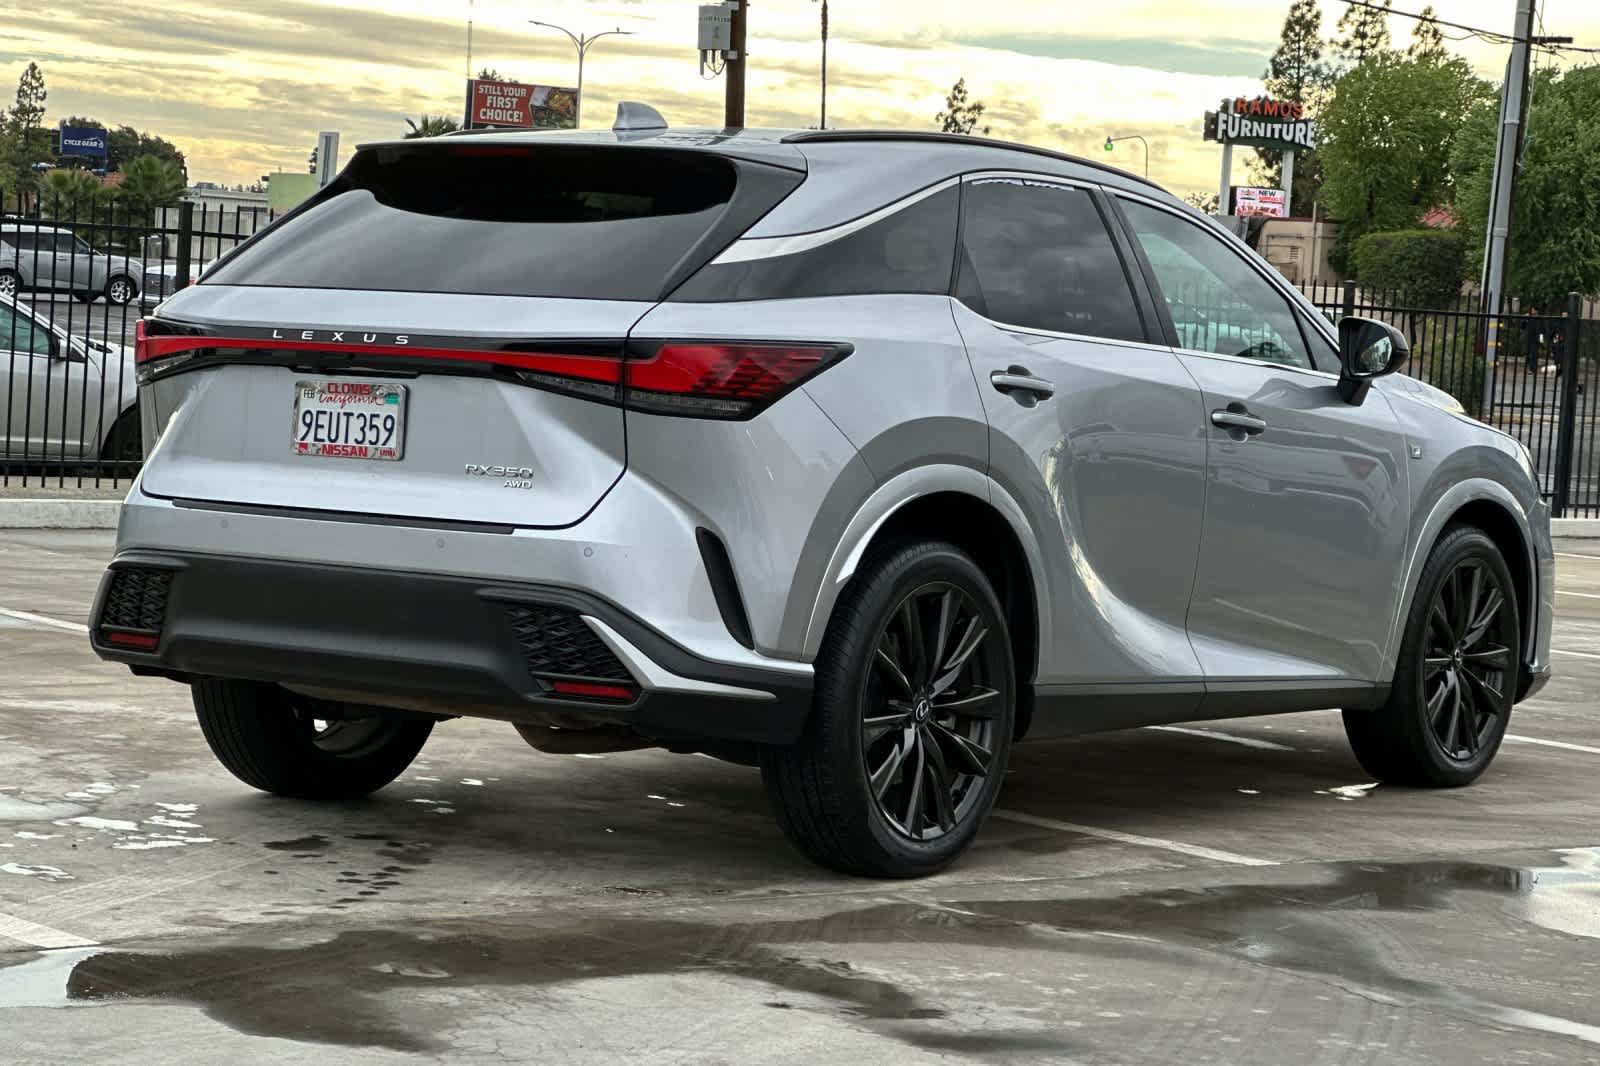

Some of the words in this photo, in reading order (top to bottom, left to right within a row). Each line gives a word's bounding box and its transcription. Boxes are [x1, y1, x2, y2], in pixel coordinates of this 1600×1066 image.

[478, 85, 501, 95] STILL
[503, 86, 527, 97] YOUR
[486, 95, 519, 109] FIRST
[1236, 98, 1303, 119] RAMOS
[480, 108, 524, 123] CHOICE!
[1217, 112, 1315, 149] FURNITURE
[272, 329, 409, 345] LEXUS
[328, 383, 371, 395] CLOVIS
[300, 409, 396, 447] 9EUT359
[322, 445, 368, 457] NISSAN
[504, 480, 533, 489] AWD
